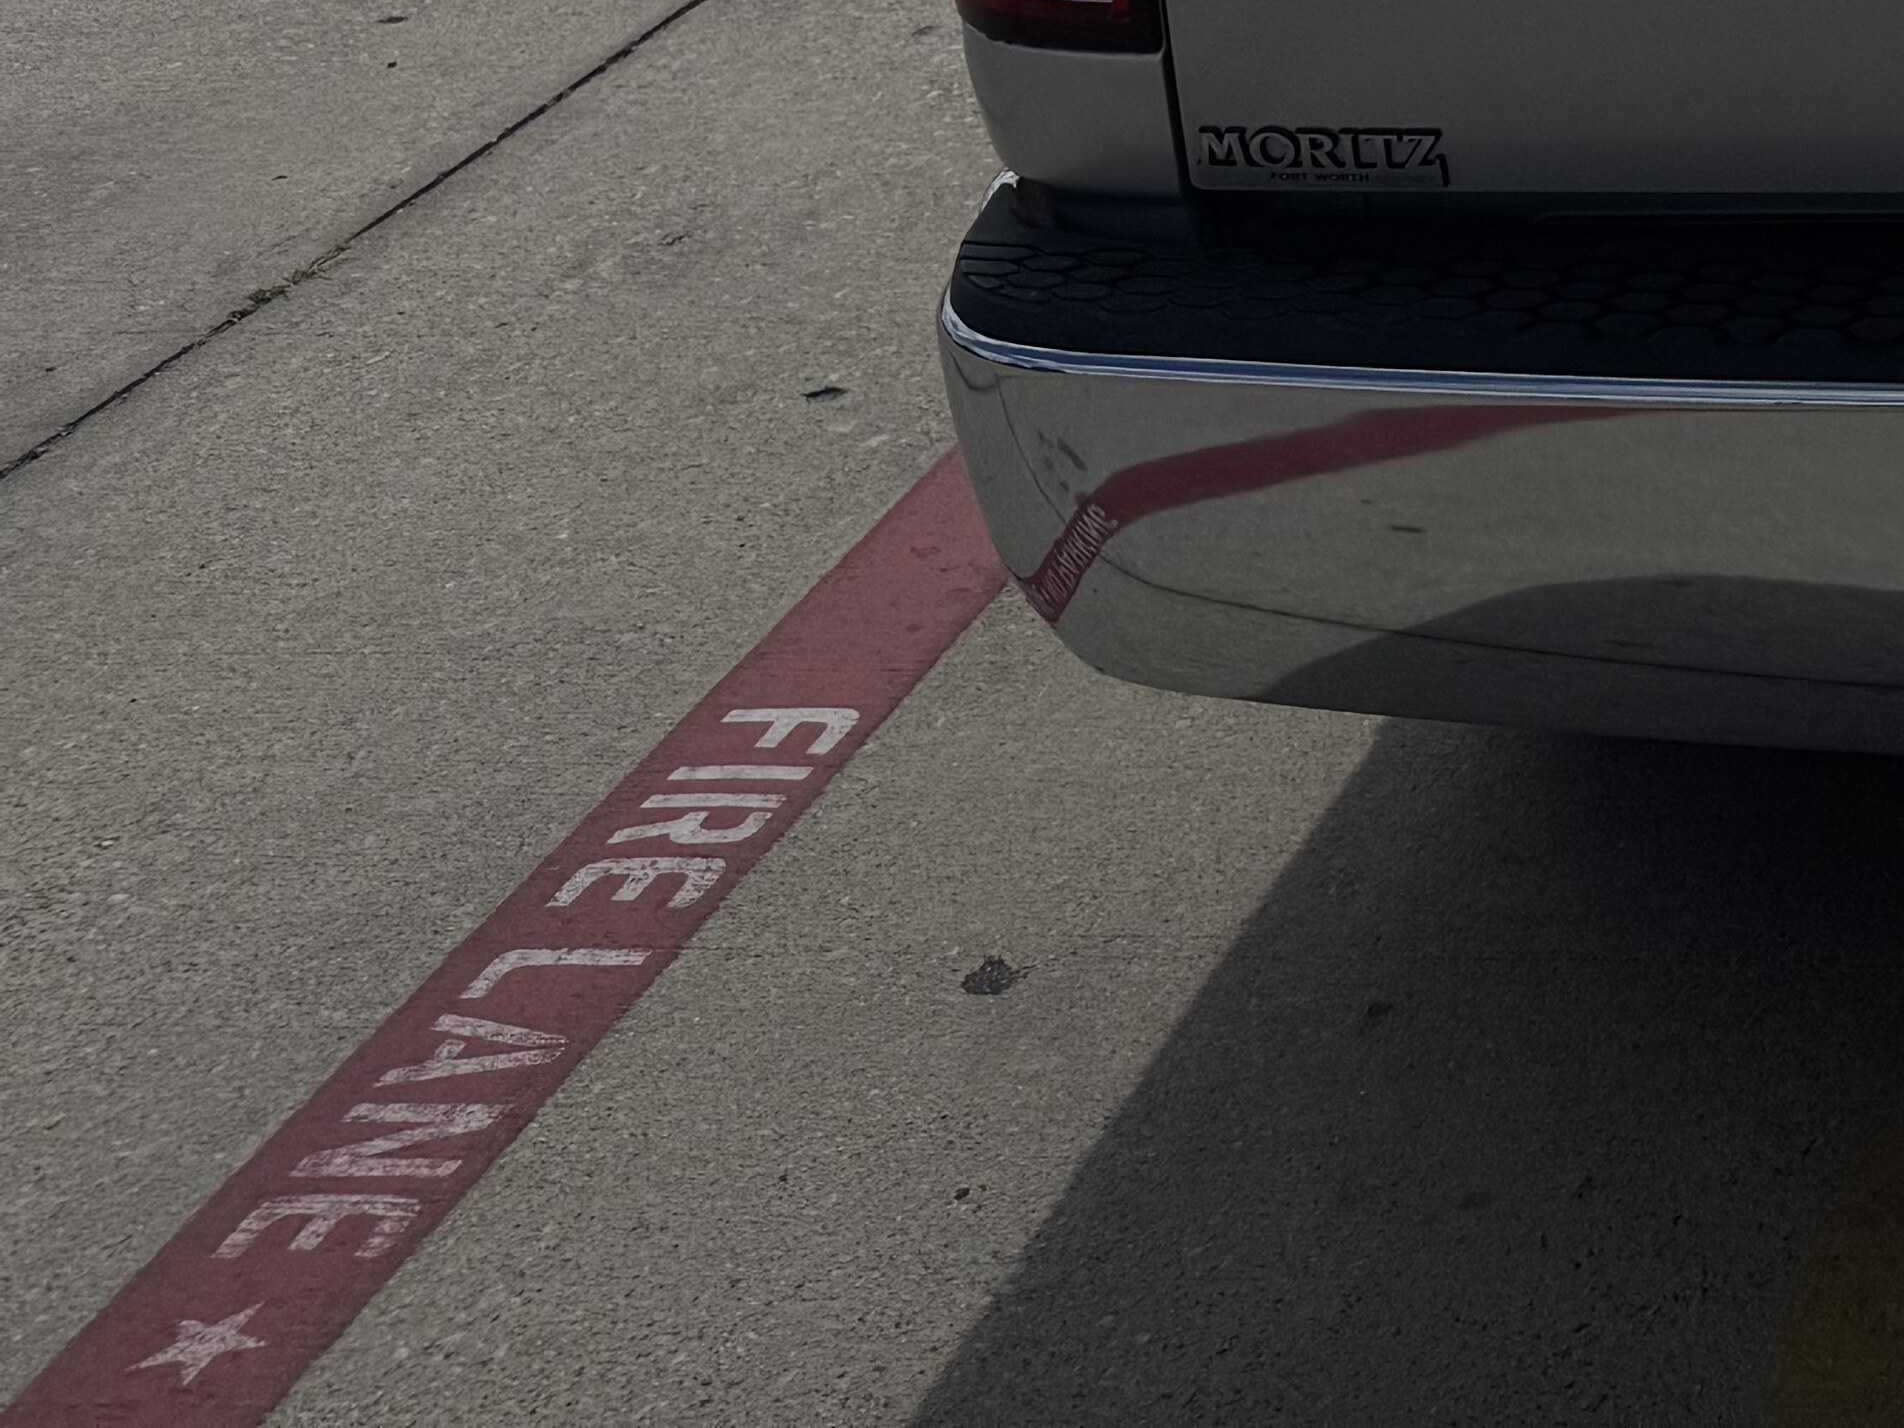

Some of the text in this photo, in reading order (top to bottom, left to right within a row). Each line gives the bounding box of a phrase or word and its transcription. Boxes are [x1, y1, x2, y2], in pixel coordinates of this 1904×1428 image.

[1198, 125, 1449, 174] MORITZ
[212, 706, 860, 1260] FIRE LANE
